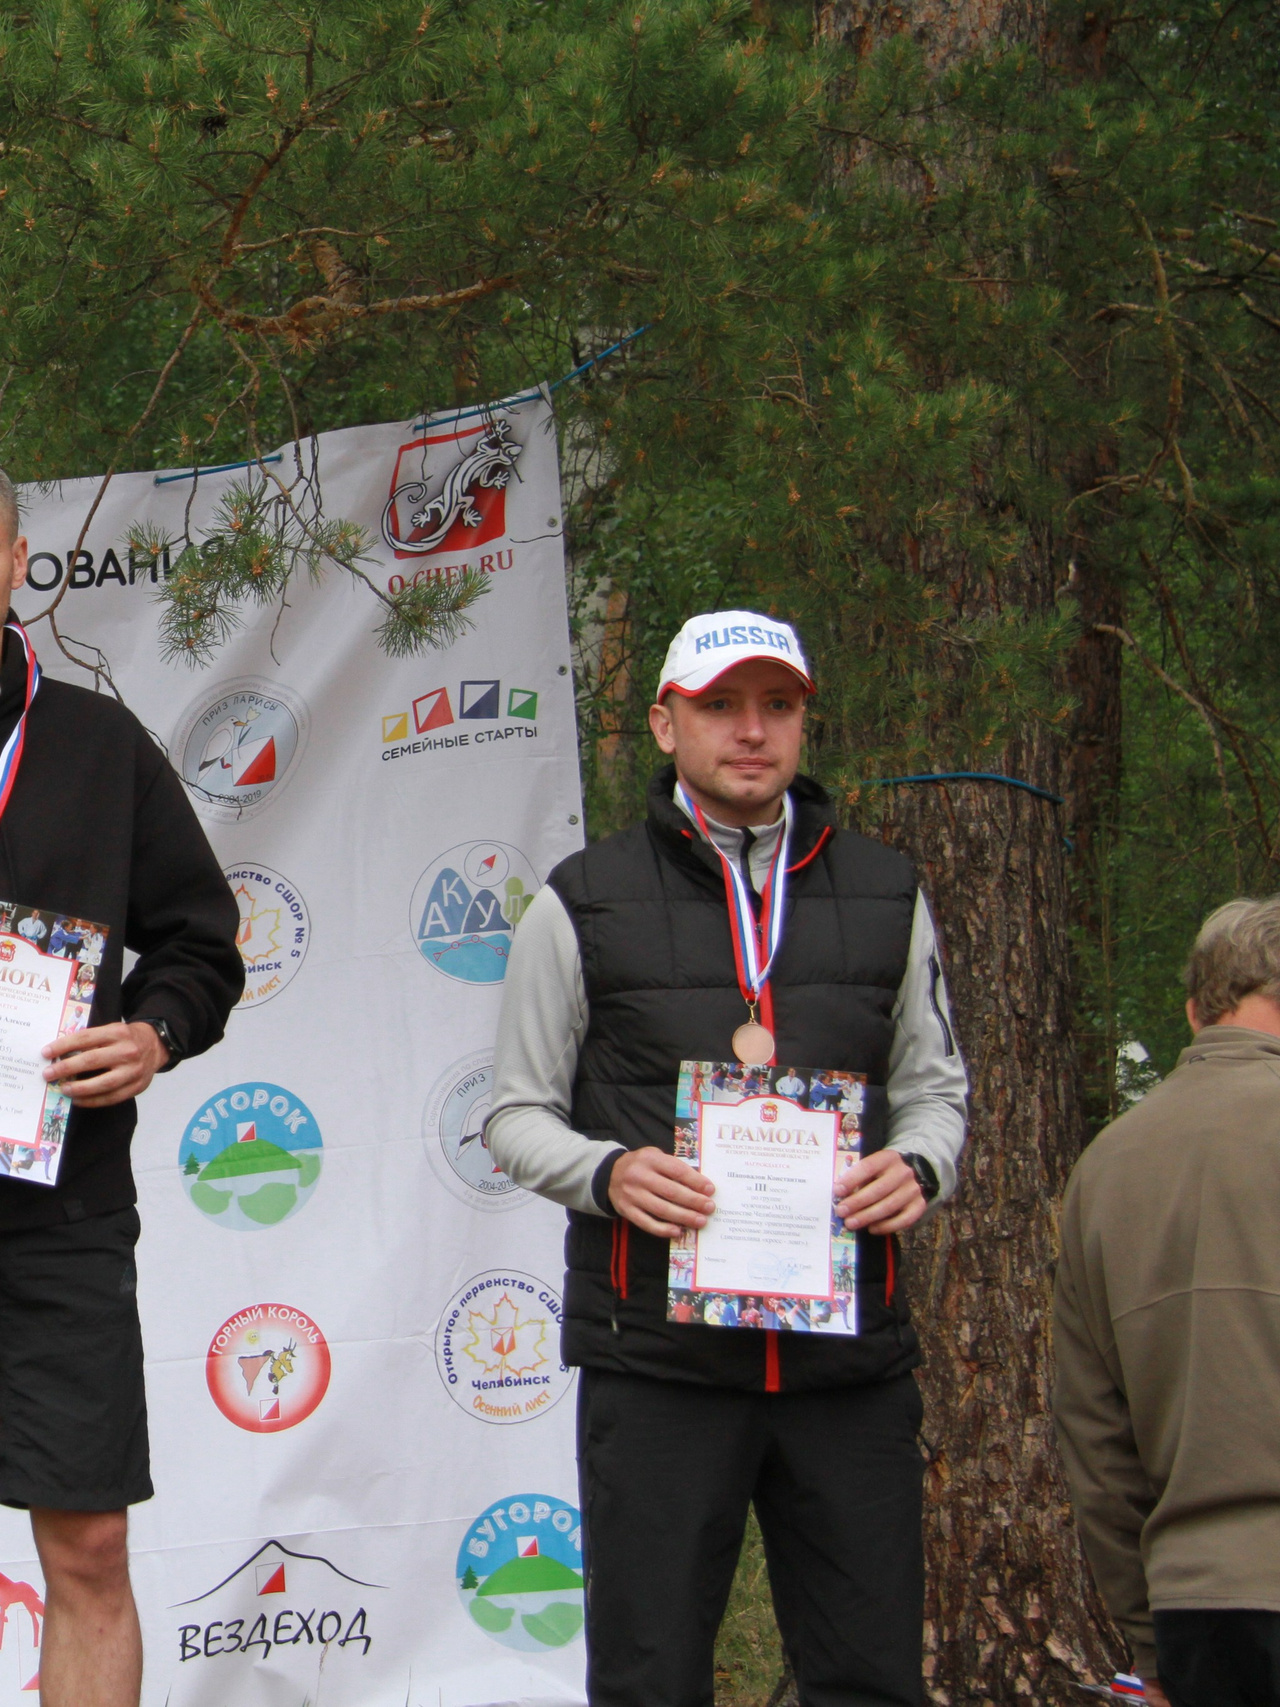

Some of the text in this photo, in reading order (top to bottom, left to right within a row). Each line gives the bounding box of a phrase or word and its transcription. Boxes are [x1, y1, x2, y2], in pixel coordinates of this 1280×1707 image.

[695, 626, 791, 654] RUSSIA
[202, 701, 229, 726] ПРИЗ
[233, 695, 279, 712] ЛАРИСЫ
[381, 726, 538, 762] СЕМЕЙНЫЕ СТАРТЫ
[226, 871, 272, 886] енство
[275, 883, 304, 922] СШОР
[290, 949, 301, 958] 5
[422, 876, 521, 937] АКУЛ
[243, 961, 282, 974] бинск
[456, 1073, 486, 1098] ПРИЗ
[189, 1089, 307, 1145] БУГОРОК
[717, 1123, 820, 1147] ГРАМОТА
[754, 1183, 767, 1192] III
[211, 1305, 320, 1355] ГОРНЫЙ КОРОЛЬ
[443, 1309, 460, 1385] Открытое
[459, 1277, 535, 1308] первенство
[538, 1291, 565, 1327] СШО
[472, 1375, 551, 1391] Челябинск
[472, 1394, 521, 1417] Осенний
[178, 1607, 371, 1662] ВЕЗДЕХОД
